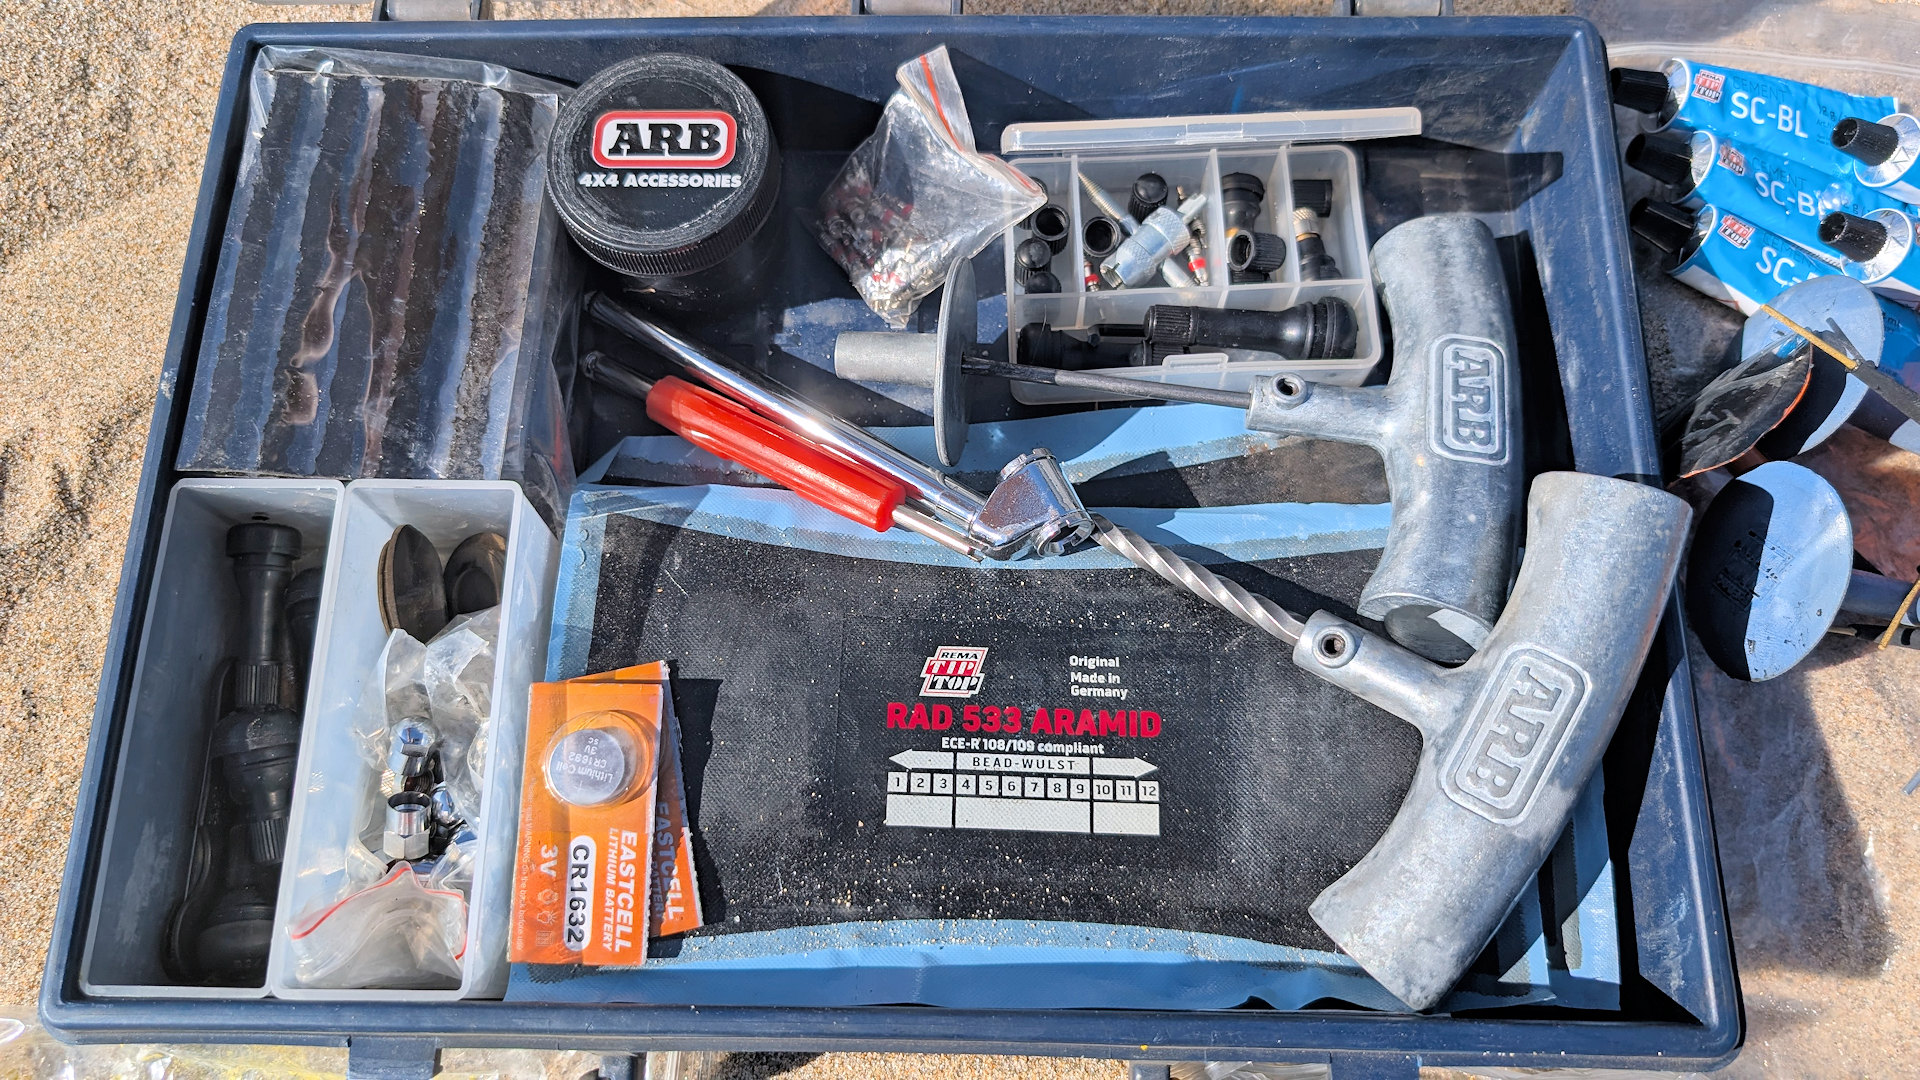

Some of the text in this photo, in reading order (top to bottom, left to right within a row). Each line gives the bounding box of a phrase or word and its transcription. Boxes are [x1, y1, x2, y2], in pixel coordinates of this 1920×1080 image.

[1698, 86, 1721, 101] TOP
[1733, 76, 1787, 102] CEMENT
[1730, 92, 1808, 138] SC-BL
[607, 122, 722, 157] ARB
[623, 172, 742, 189] ACCESSORIES
[1724, 228, 1749, 247] TOP
[1450, 349, 1491, 448] ARB
[929, 661, 976, 676] TIP
[1069, 655, 1120, 669] Original
[932, 675, 979, 690] TOP
[1070, 672, 1121, 684] Made in
[1070, 686, 1128, 700] Germany
[886, 702, 1162, 738] RAD 533 ARAMID
[1465, 665, 1564, 799] ARB
[584, 744, 598, 755] 3V
[981, 739, 1035, 752] 108/109
[1037, 741, 1105, 756] compliant
[555, 760, 614, 784] Lithium Cell
[972, 757, 1076, 771] BEAD-WULST
[895, 778, 1157, 797] 1 2 3 4 5 6 7 8 9 10 11 12
[521, 822, 533, 863] WARNING
[540, 844, 559, 877] 3V
[657, 802, 685, 920] EASTCELL
[567, 844, 590, 943] CR1632
[602, 827, 618, 951] LITHIUM BATTERY
[614, 829, 638, 953] EASTCELL
